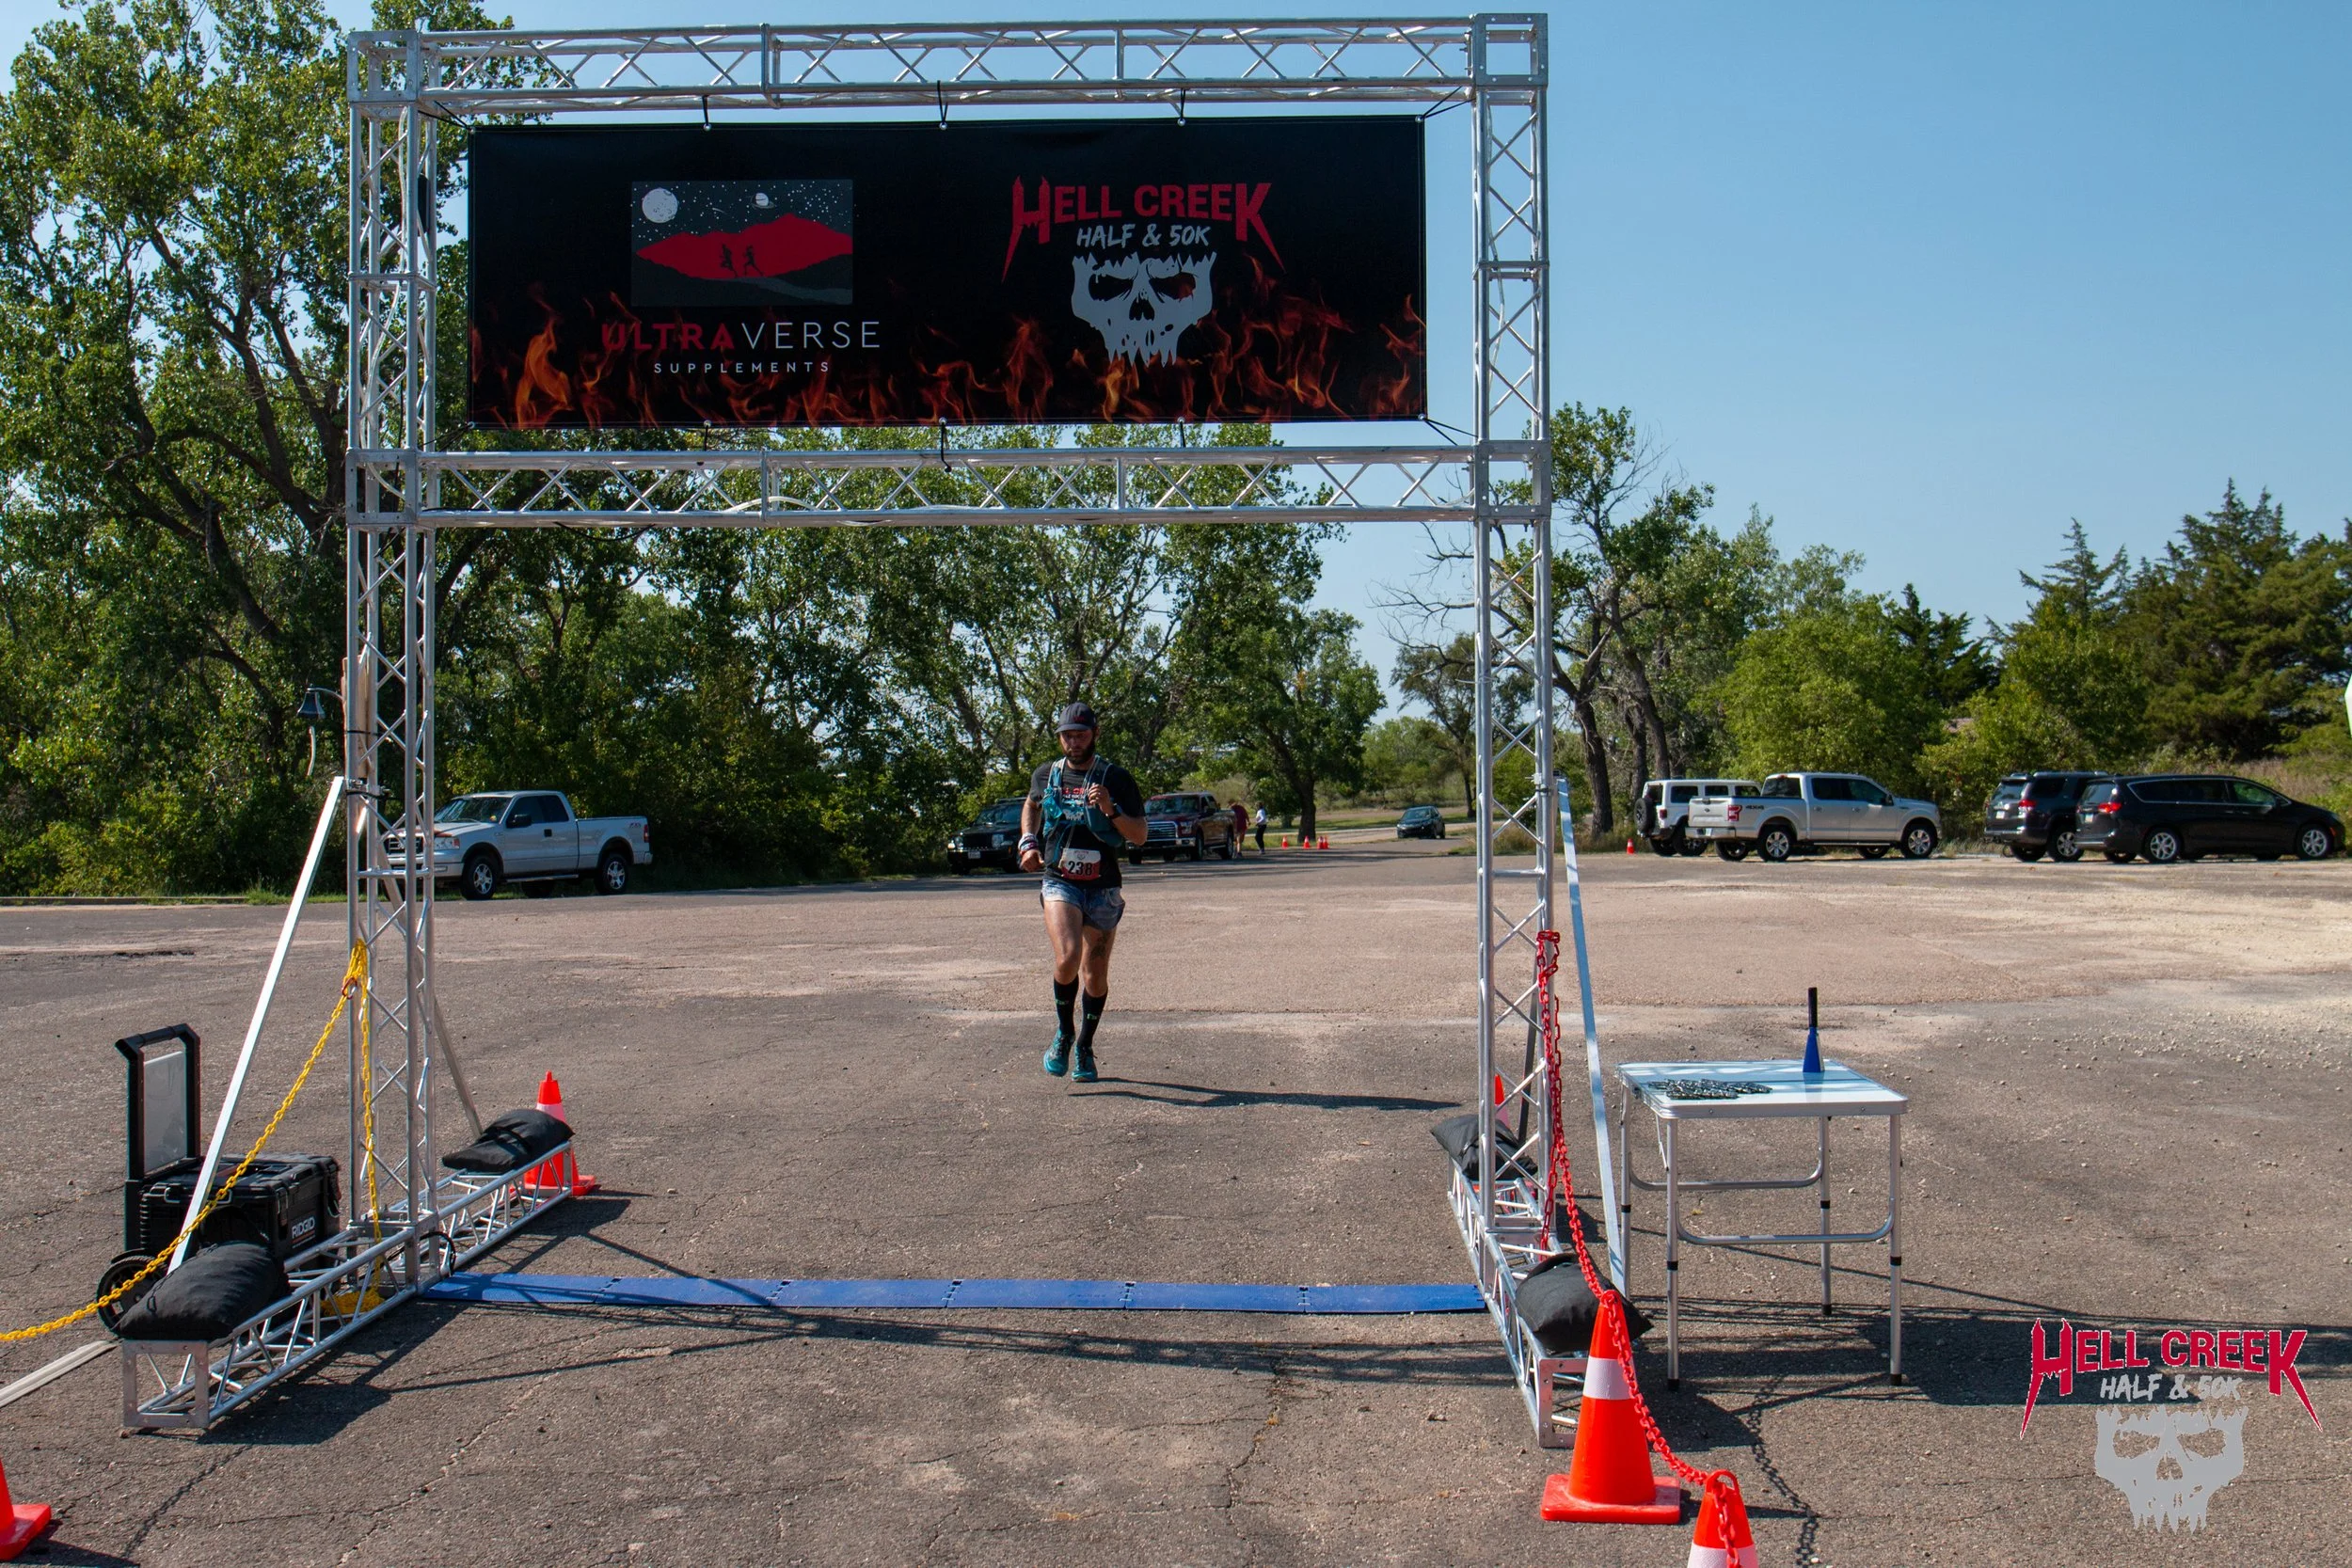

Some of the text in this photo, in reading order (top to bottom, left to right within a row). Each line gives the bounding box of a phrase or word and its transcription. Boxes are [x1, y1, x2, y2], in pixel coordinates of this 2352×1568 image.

[1001, 175, 1286, 282] HELL CREEK
[1076, 224, 1212, 248] HALF & 50K
[601, 321, 881, 351] ULTRAVERSE
[654, 361, 830, 373] SUPPLEMENTS
[1068, 861, 1092, 876] 238
[292, 1216, 315, 1239] RIDGID
